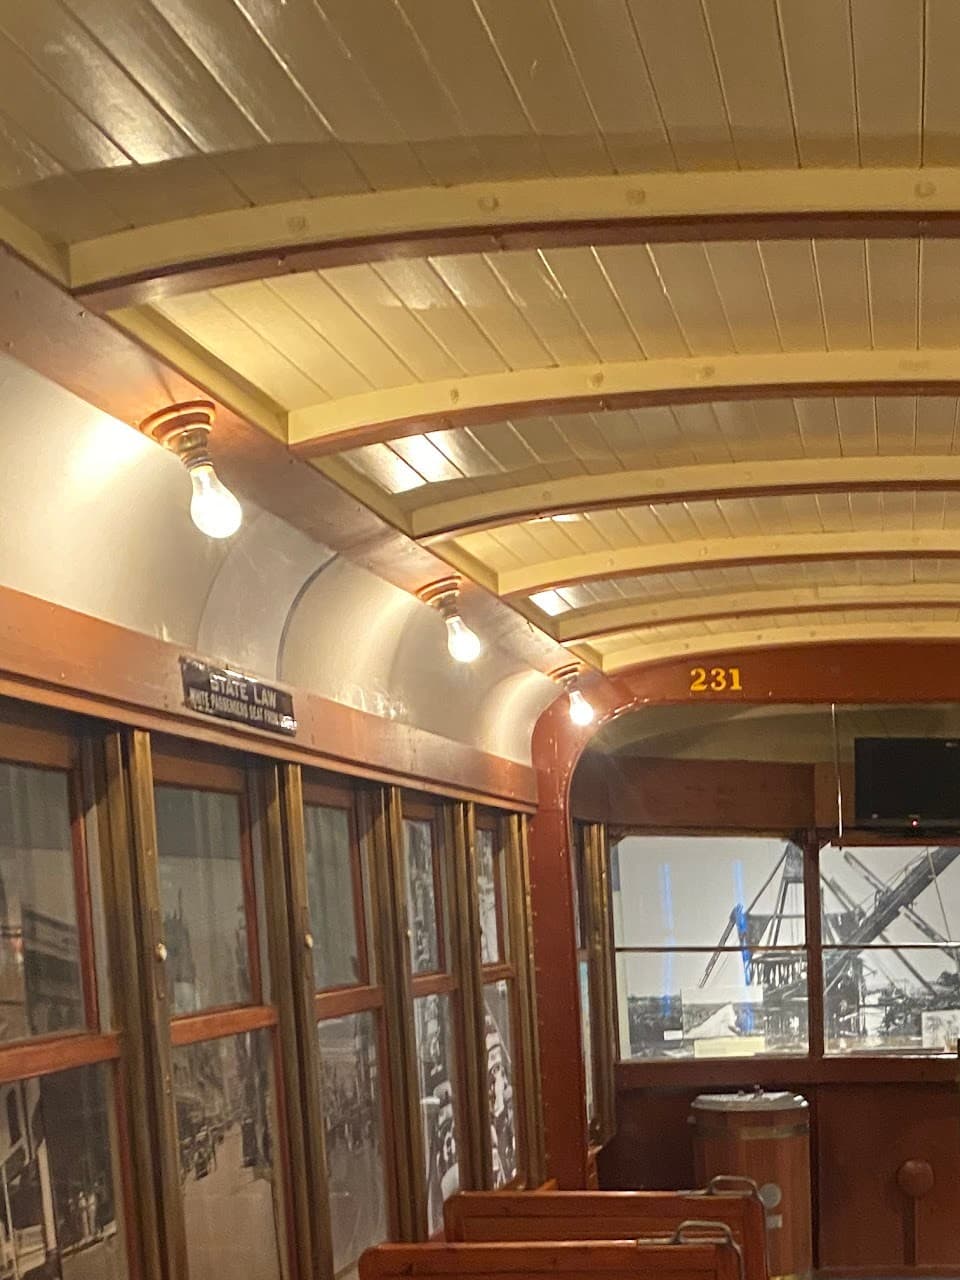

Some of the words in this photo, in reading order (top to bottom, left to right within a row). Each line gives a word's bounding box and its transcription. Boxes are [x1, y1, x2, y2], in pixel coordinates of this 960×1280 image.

[209, 674, 249, 701] STATE
[253, 685, 277, 709] LAW
[690, 667, 743, 691] 231
